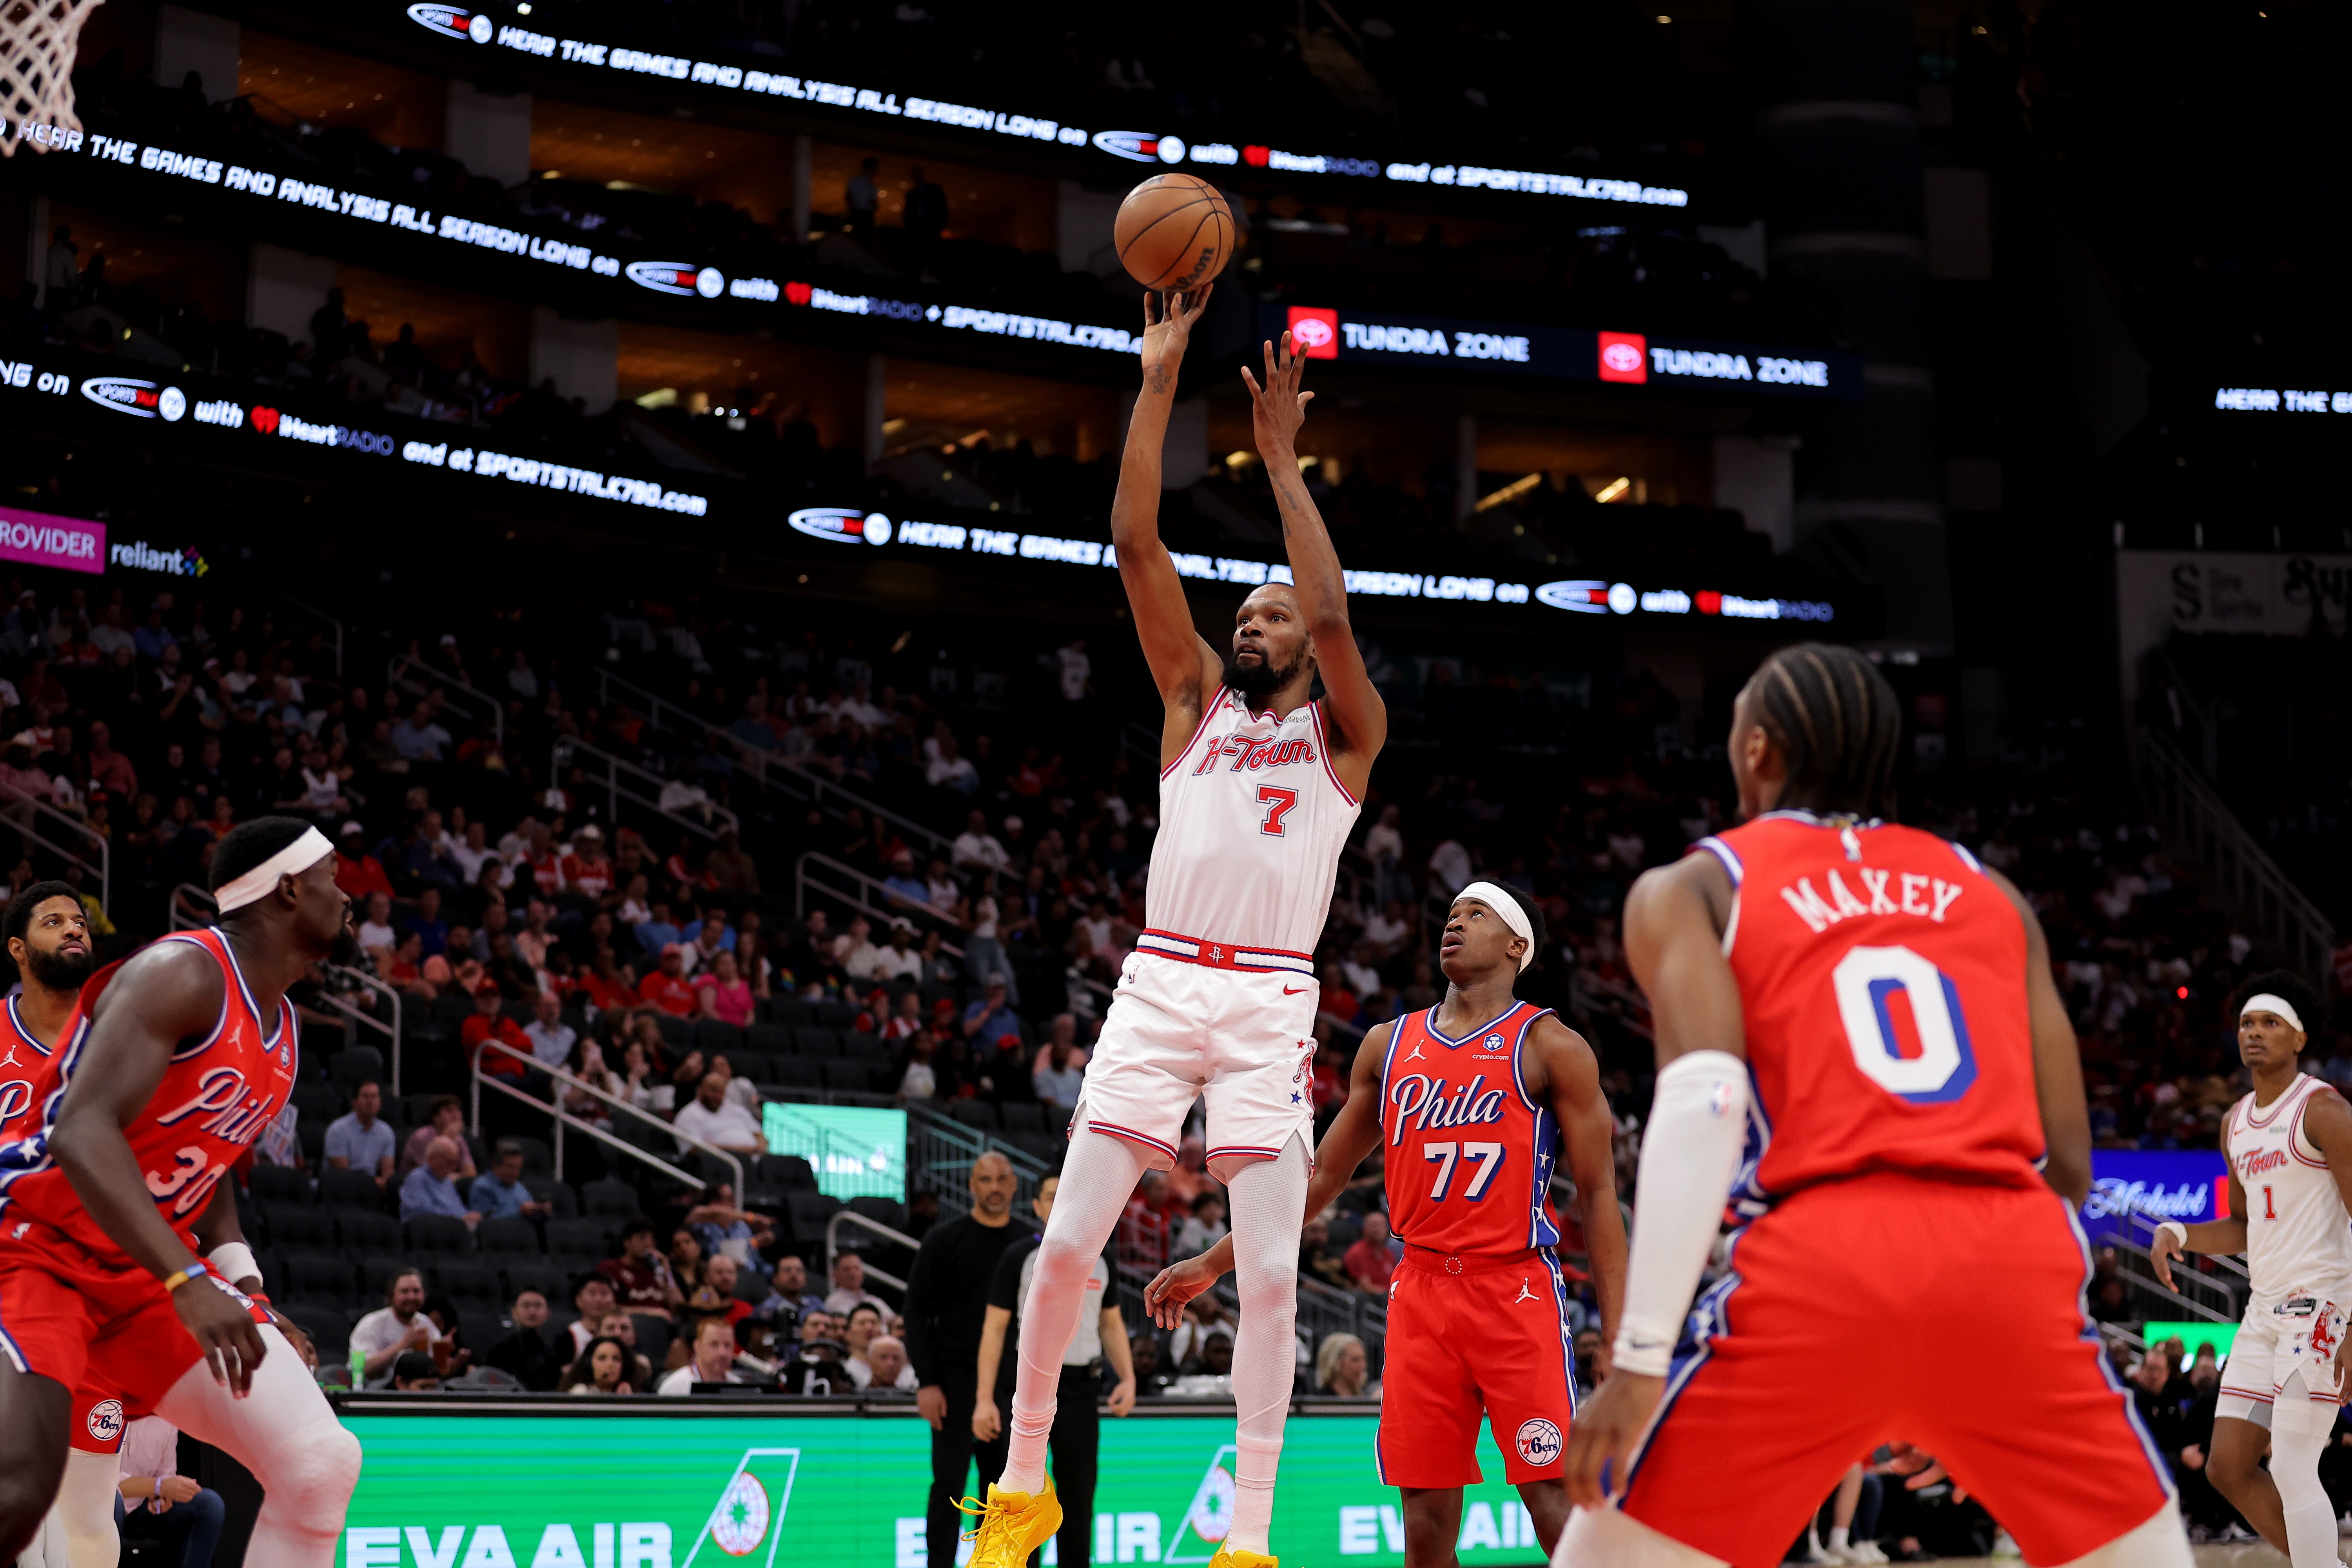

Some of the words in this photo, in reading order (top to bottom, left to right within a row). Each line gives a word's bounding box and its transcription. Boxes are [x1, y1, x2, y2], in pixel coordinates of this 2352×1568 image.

[497, 25, 556, 57] HEAR
[560, 40, 608, 66] THE
[609, 48, 691, 79] GAMES
[691, 62, 743, 88] AND
[743, 70, 856, 106] ANALYSIS
[855, 89, 902, 114] ALL
[903, 97, 995, 131] SEASON
[995, 113, 1058, 141] LONG
[1058, 127, 1087, 146] on
[1190, 143, 1238, 165] with
[1386, 162, 1431, 182] and
[1430, 165, 1457, 185] at
[17, 119, 83, 152] HEAR
[90, 134, 137, 164] THE
[141, 146, 223, 184] GAMES
[224, 165, 276, 196] AND
[277, 178, 391, 222] ANALYSIS
[390, 204, 436, 234] ALL
[438, 215, 529, 255] SEASON
[529, 236, 591, 270] LONG
[591, 255, 620, 277] on
[730, 277, 779, 302] with
[942, 305, 1143, 354] SPORTSTALK790.c
[1165, 247, 1214, 291] ilson
[1342, 323, 1450, 355] TUNDRA
[1454, 332, 1529, 362] ZONE
[1650, 348, 1753, 381] TUNDRA
[1756, 357, 1829, 387] ZONE
[2215, 388, 2280, 411] HEAR
[2283, 390, 2329, 413] THE
[37, 372, 70, 395] on
[194, 399, 244, 428] with
[403, 441, 447, 467] and
[448, 447, 473, 472] at
[474, 450, 707, 517] SPORTSTALK790.com
[111, 540, 185, 576] reliant
[898, 520, 967, 550] HEAR
[969, 528, 1019, 556] THE
[1019, 534, 1103, 565] GAMES
[1168, 551, 1269, 585] NALYSIS
[1342, 569, 1423, 597] EASON
[1423, 575, 1495, 601] LONG
[1495, 583, 1529, 604] on
[1641, 589, 1691, 614] with
[1192, 733, 1316, 776] H-Town
[1256, 783, 1299, 837] 7
[1780, 867, 1962, 934] MAXEY
[1833, 945, 1979, 1105] 0
[158, 1066, 274, 1145] Phila
[1391, 1074, 1507, 1146] Phila
[145, 1146, 227, 1217] 30
[1423, 1142, 1506, 1202] 77
[2262, 1184, 2278, 1222] 1
[91, 1414, 119, 1430] 76ers
[1521, 1437, 1557, 1455] 76ers
[345, 1525, 519, 1568] EVA
[530, 1522, 673, 1568] AIR
[1339, 1504, 1406, 1555] EV
